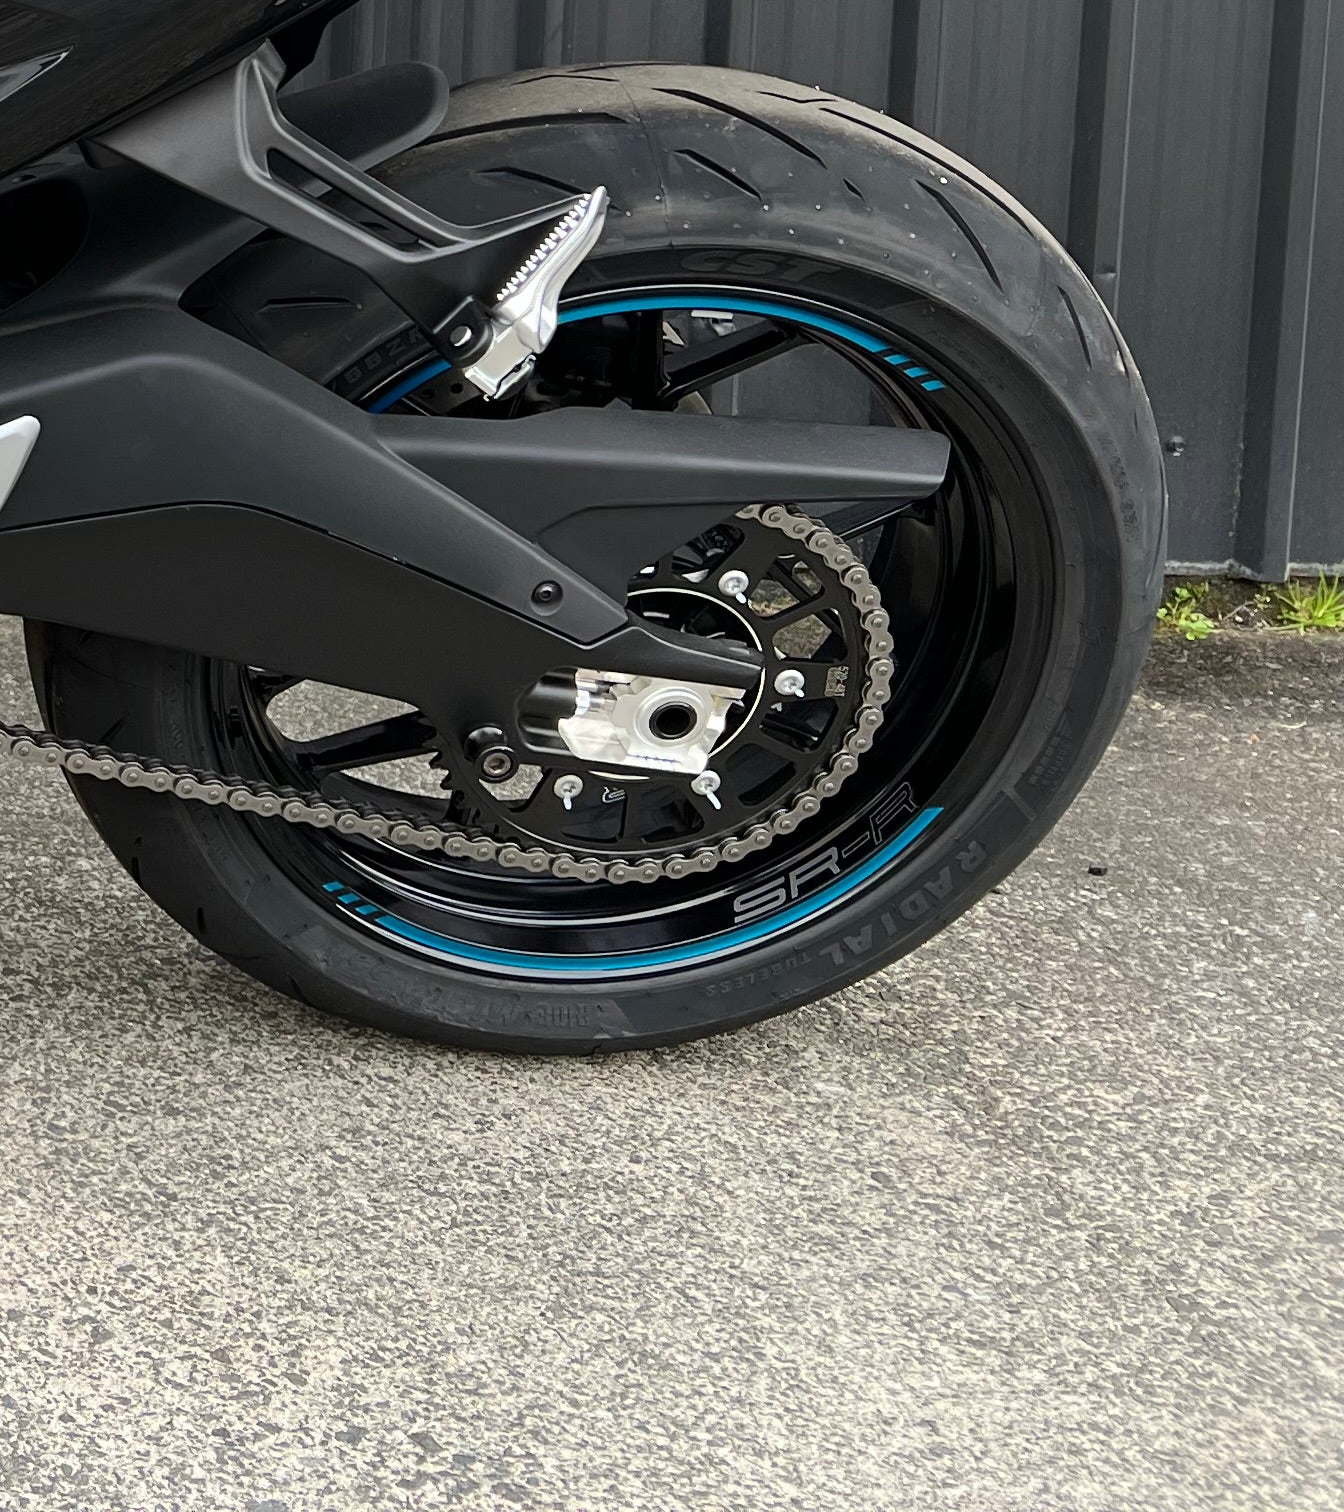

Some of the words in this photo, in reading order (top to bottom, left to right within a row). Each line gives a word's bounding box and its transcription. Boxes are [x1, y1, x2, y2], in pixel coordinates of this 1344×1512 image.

[679, 249, 844, 282] CST
[733, 781, 918, 925] SR-R
[818, 839, 990, 969] RADIAL
